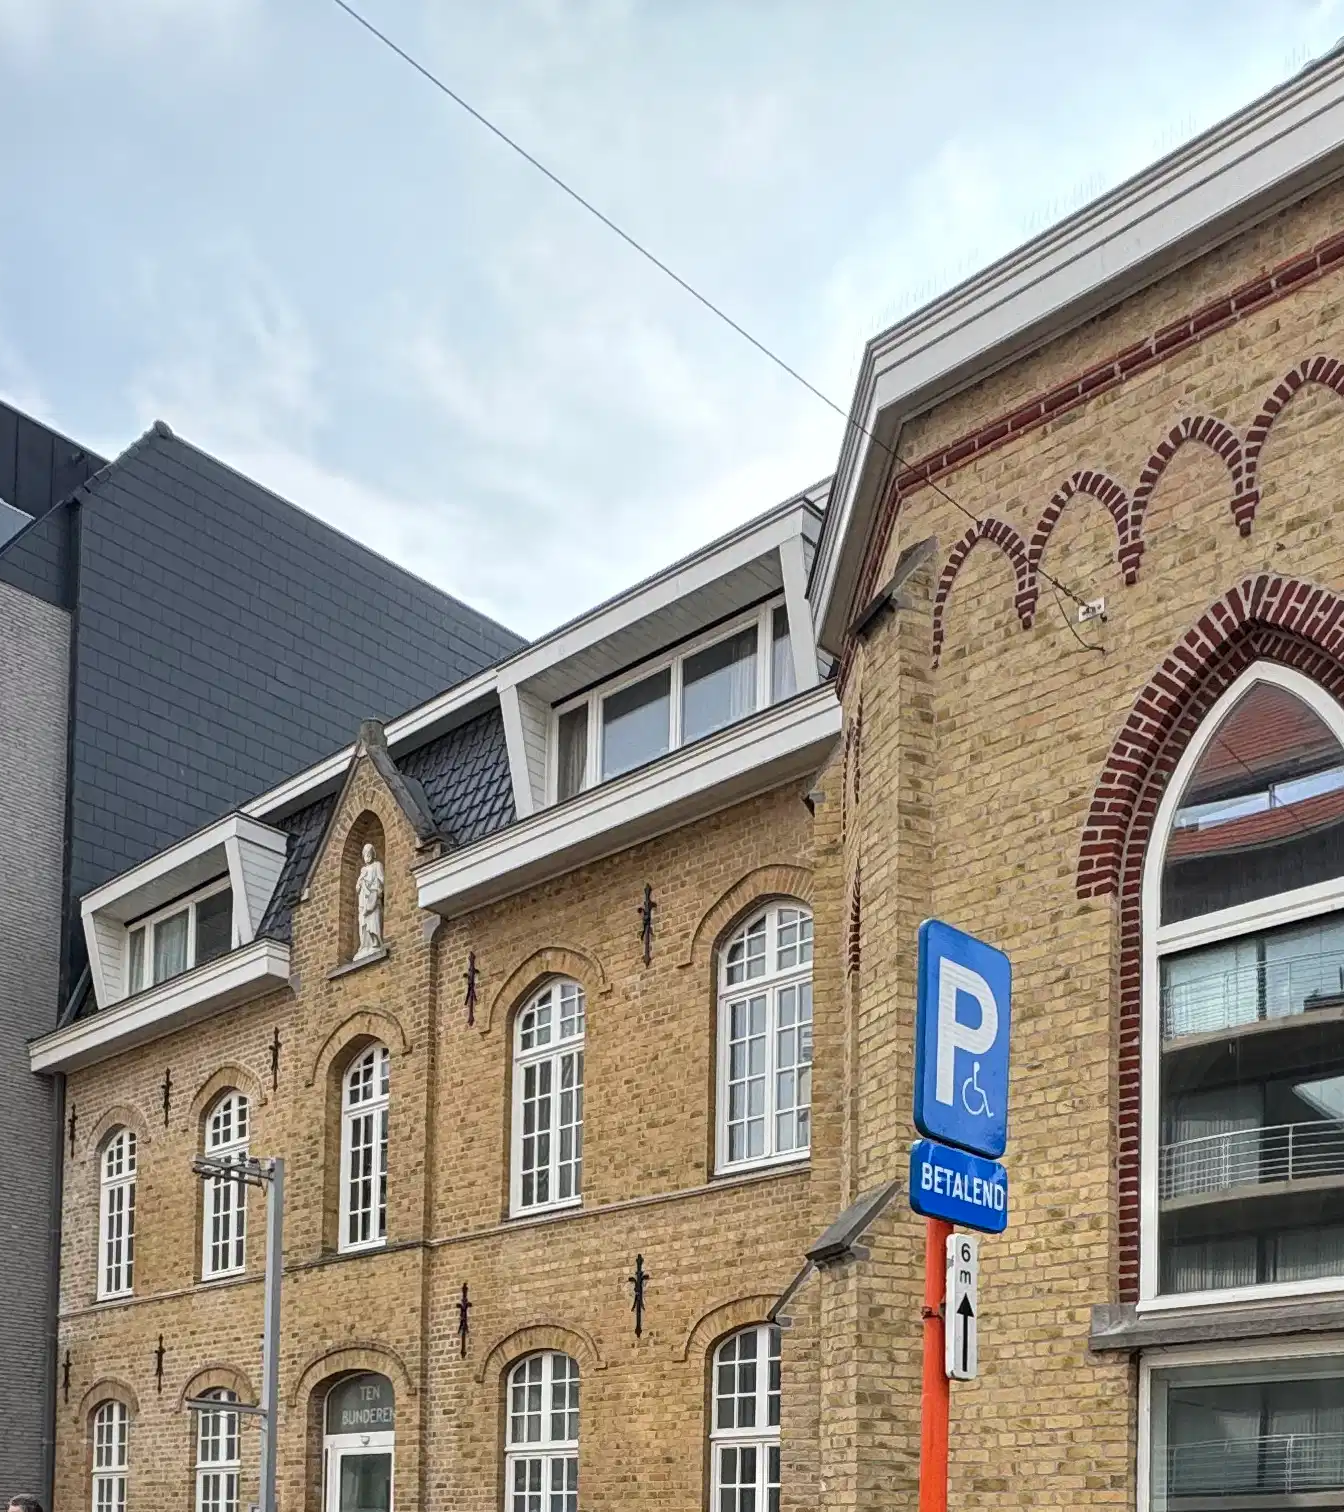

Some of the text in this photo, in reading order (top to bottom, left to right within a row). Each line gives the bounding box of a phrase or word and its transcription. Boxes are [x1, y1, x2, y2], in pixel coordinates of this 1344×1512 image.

[936, 955, 999, 1107] P
[921, 1162, 1005, 1212] BETALEND
[960, 1242, 971, 1263] 6
[959, 1269, 972, 1285] m
[359, 1385, 381, 1401] TEN
